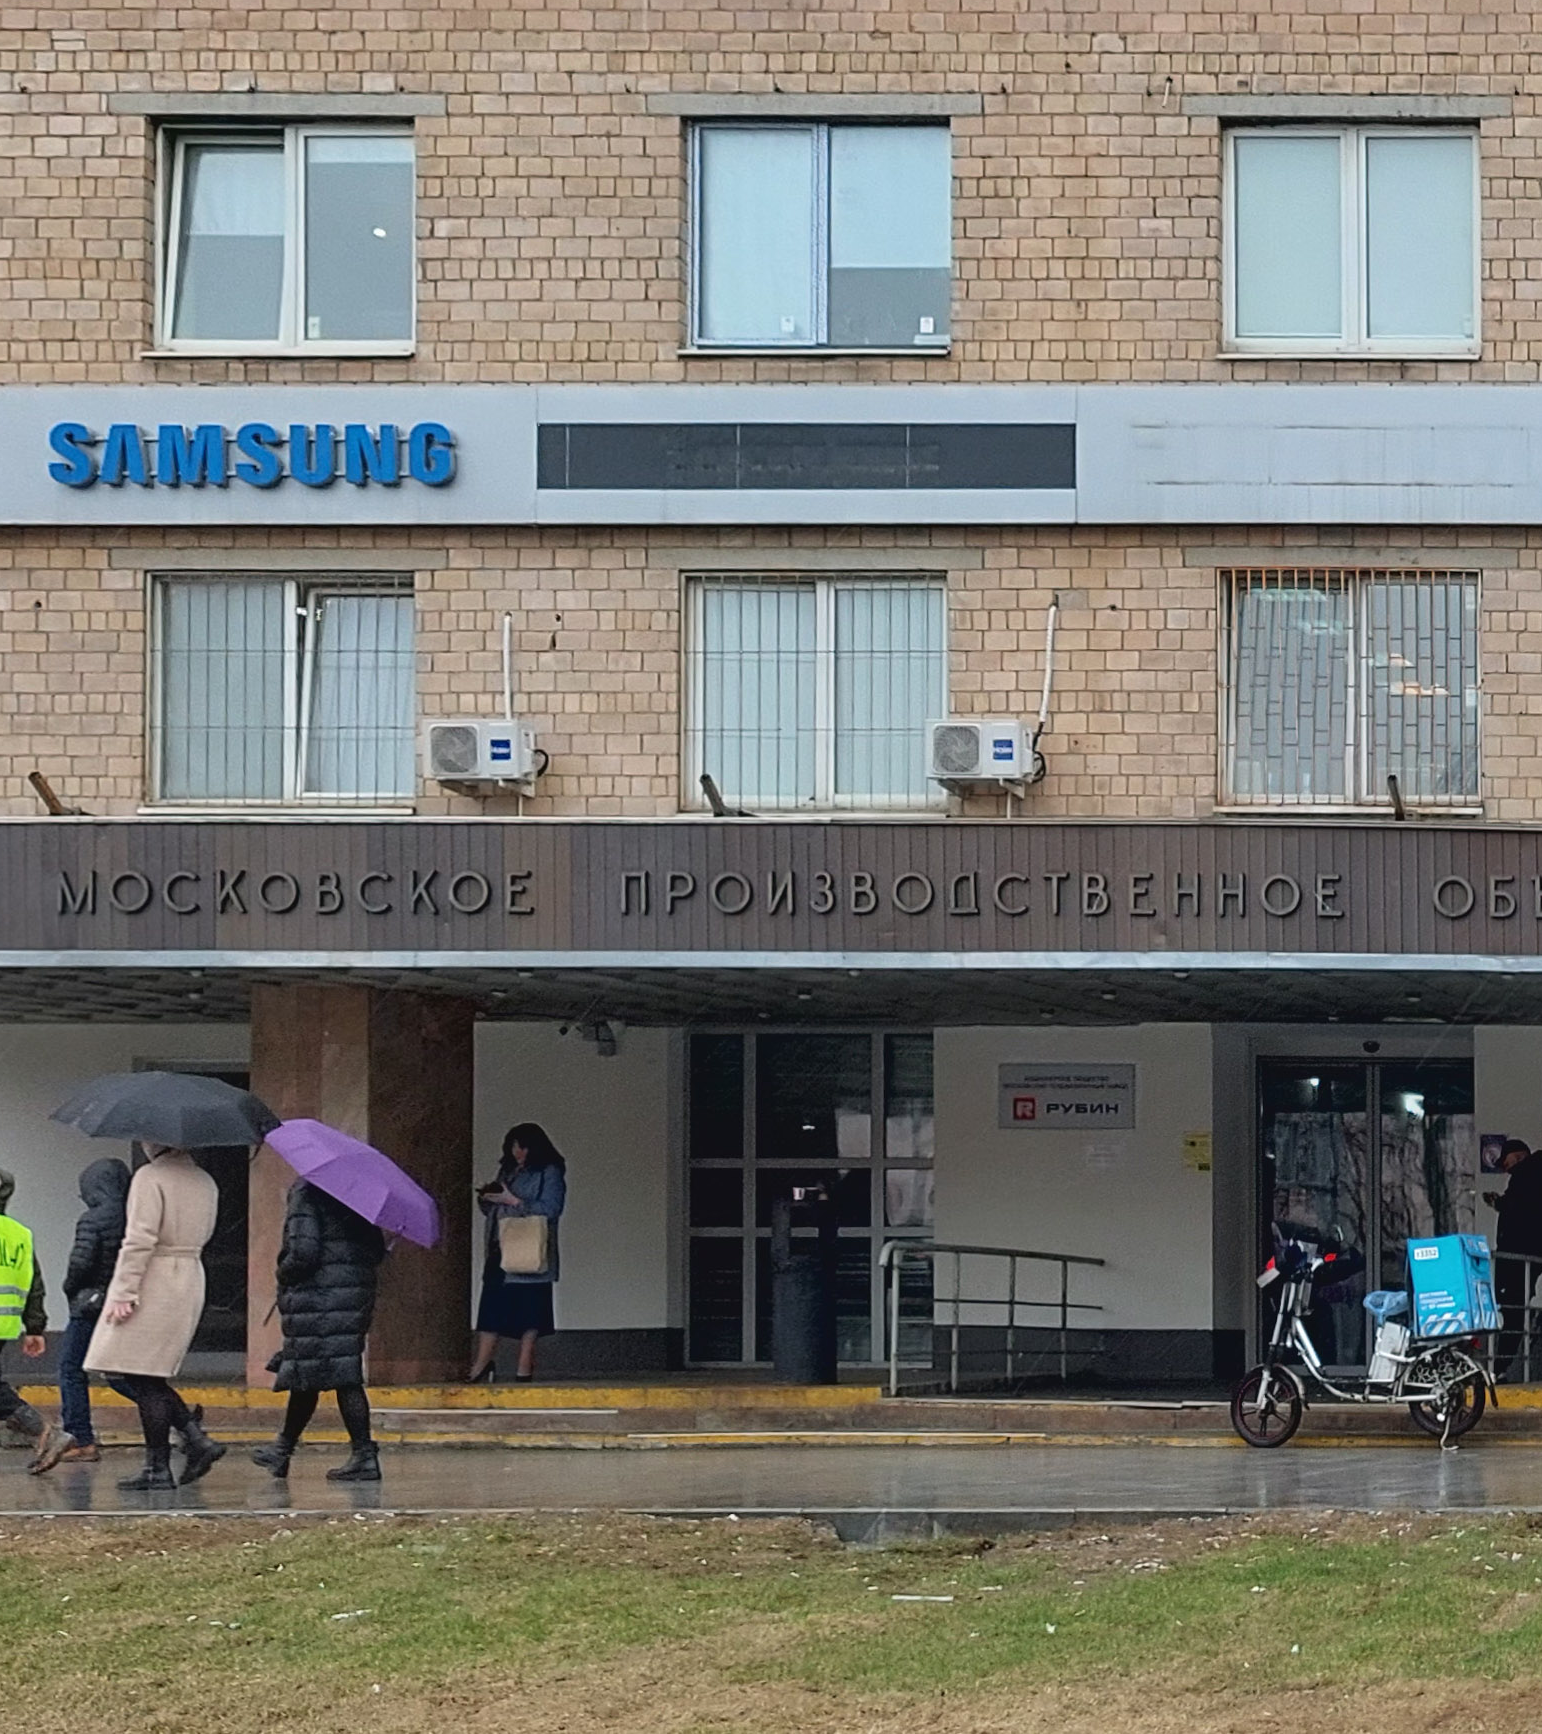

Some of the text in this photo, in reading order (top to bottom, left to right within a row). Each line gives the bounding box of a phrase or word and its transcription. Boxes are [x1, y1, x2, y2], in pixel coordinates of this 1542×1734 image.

[48, 420, 458, 490] SAMSUNG
[59, 868, 536, 915] МОСКОВСКОЕ
[620, 869, 1346, 918] ПРОИЗВОДСТВЕННОЕ
[1046, 1103, 1119, 1114] РУБИН
